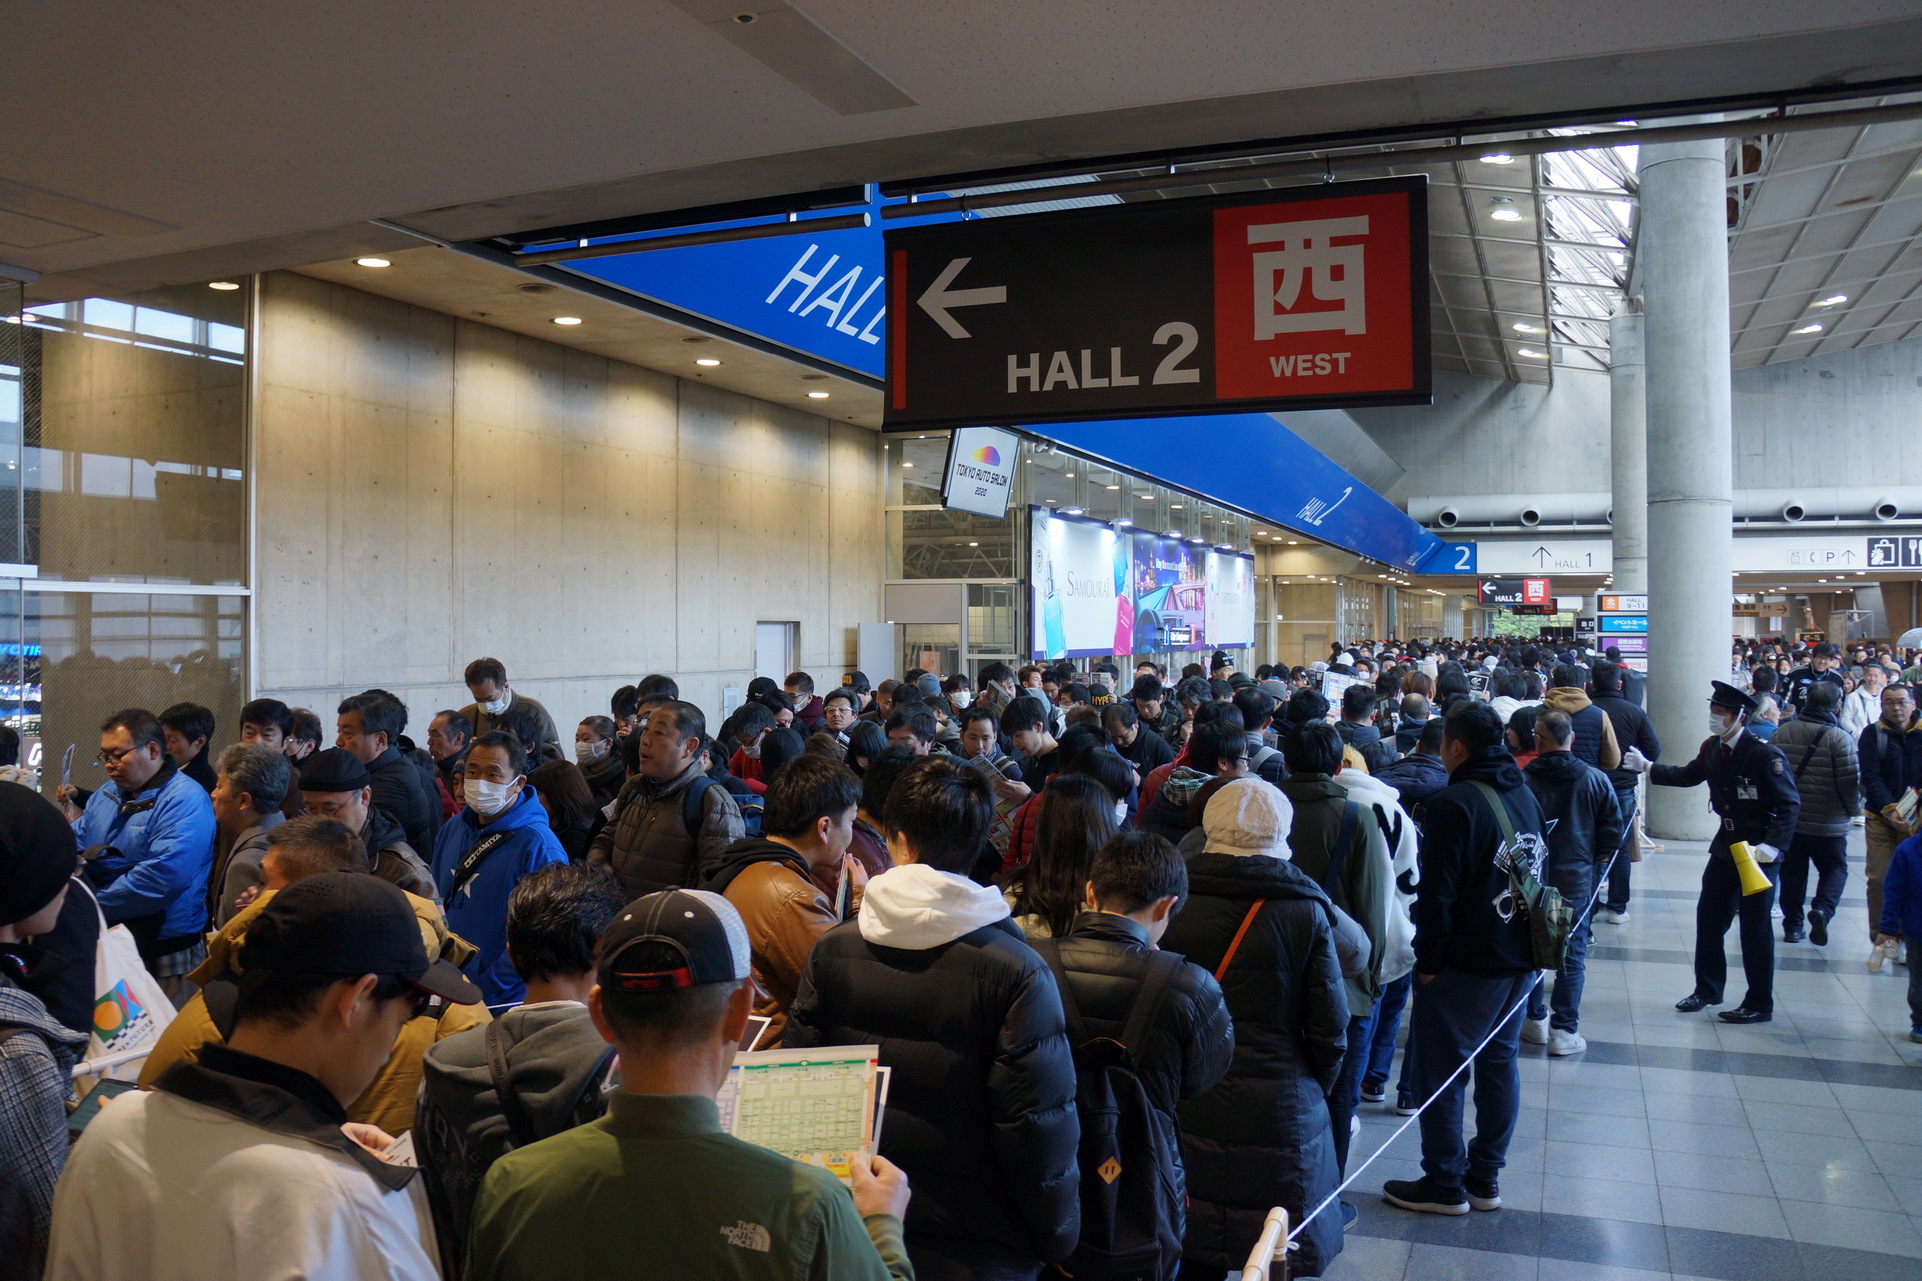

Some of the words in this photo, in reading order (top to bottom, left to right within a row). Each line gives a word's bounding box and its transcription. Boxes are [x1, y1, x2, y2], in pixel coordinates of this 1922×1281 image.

[1247, 214, 1370, 341] 西
[765, 243, 886, 346] HALL
[1007, 347, 1140, 394] HALL
[1151, 321, 1200, 385] 2
[1269, 352, 1352, 378] WEST
[956, 463, 976, 480] TOKYO
[975, 468, 991, 483] AUTO
[990, 473, 1009, 487] SALON
[974, 486, 988, 497] 2020
[1454, 545, 1471, 570] 2
[1554, 560, 1580, 568] HALL
[1585, 552, 1592, 568] 1
[1514, 592, 1523, 602] 2
[1527, 580, 1545, 597] 西
[475, 833, 502, 857] TAMIYA
[720, 1226, 755, 1240] NORTH
[728, 1235, 756, 1249] FACE
